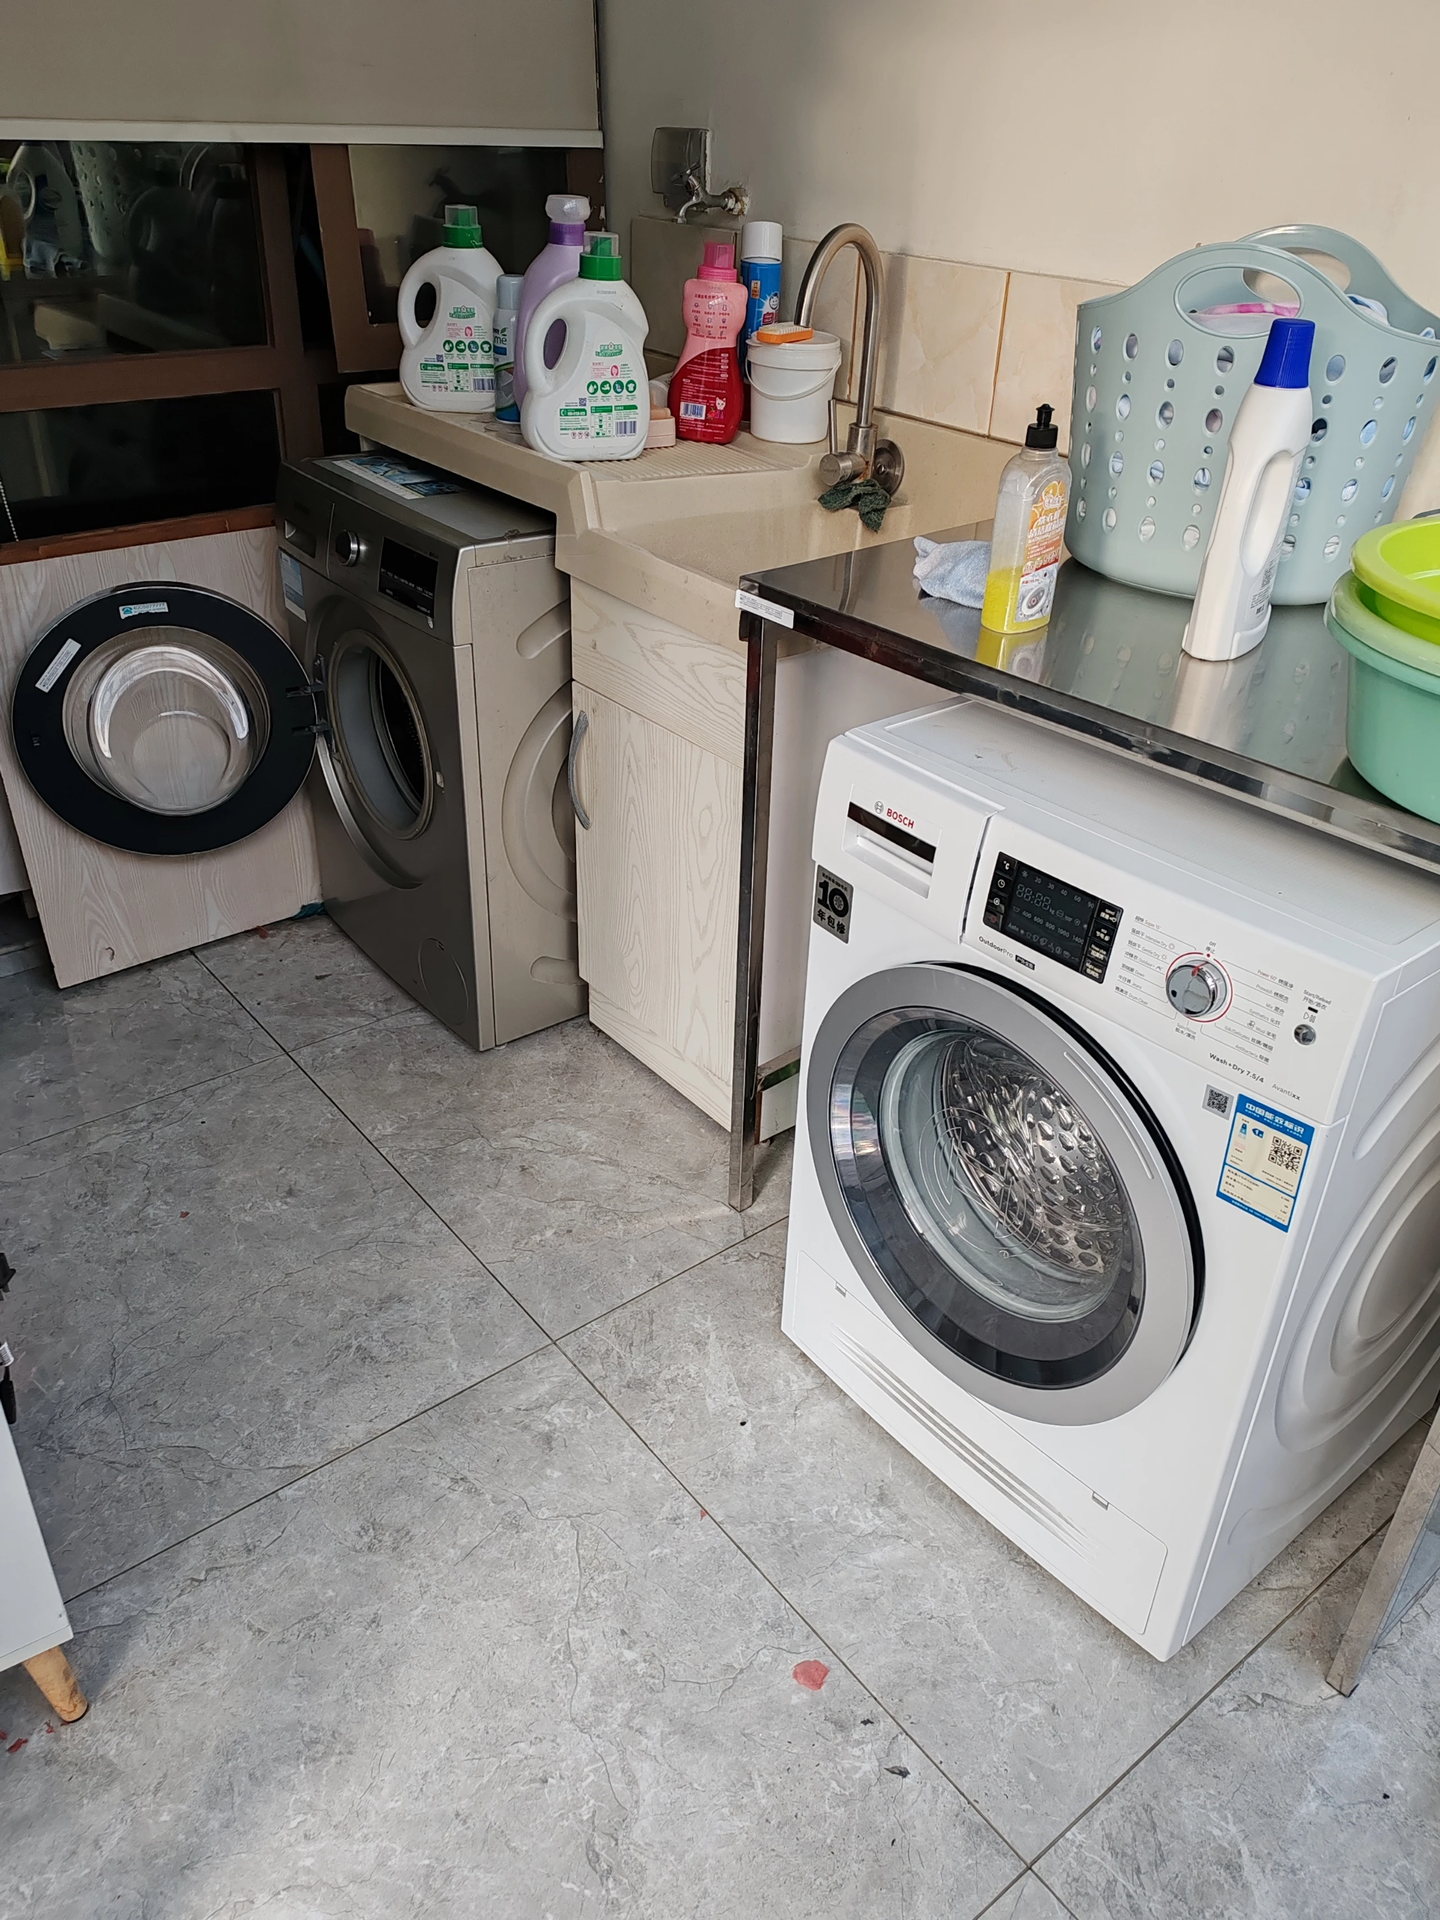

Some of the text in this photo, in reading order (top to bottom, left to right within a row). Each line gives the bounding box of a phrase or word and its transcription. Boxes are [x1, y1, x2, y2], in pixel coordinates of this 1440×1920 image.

[886, 807, 915, 829] BOSCH
[817, 879, 849, 918] 10
[817, 908, 846, 935] 年包修
[978, 935, 1014, 959] OutdoorPro
[1209, 1052, 1265, 1084] Wash+Dry 7.5/4
[1271, 1083, 1301, 1101] Avantixx
[1245, 1102, 1305, 1135] 中国能效标识
